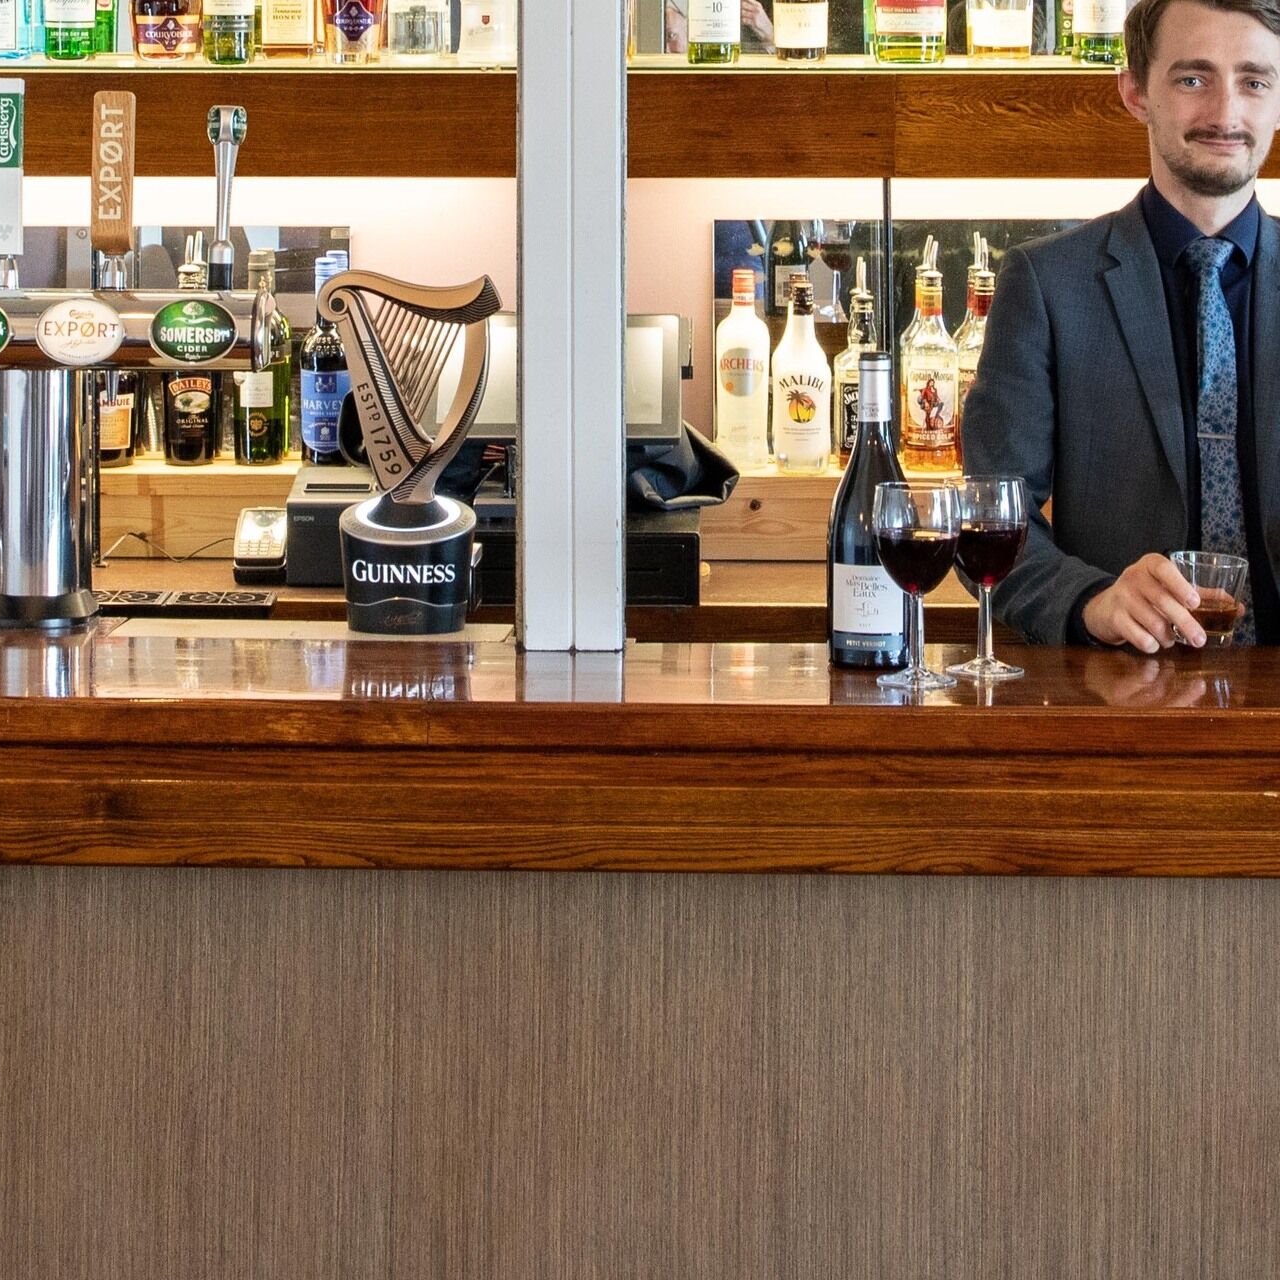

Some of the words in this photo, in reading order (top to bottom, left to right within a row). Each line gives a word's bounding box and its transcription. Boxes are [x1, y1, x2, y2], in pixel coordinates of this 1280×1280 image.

[711, 2, 723, 13] 10
[145, 30, 192, 39] COURVOISIER
[160, 327, 230, 344] SOMERSBY
[177, 345, 208, 353] CIDER
[720, 358, 764, 372] ARCHERS
[910, 371, 933, 382] Captain
[172, 378, 212, 392] BAILEYS
[779, 375, 825, 393] MALIBU
[101, 398, 130, 408] MBUIE
[370, 425, 402, 477] 1759
[352, 559, 456, 584] GUINNESS
[861, 582, 888, 591] Belles
[853, 588, 877, 599] Eaux
